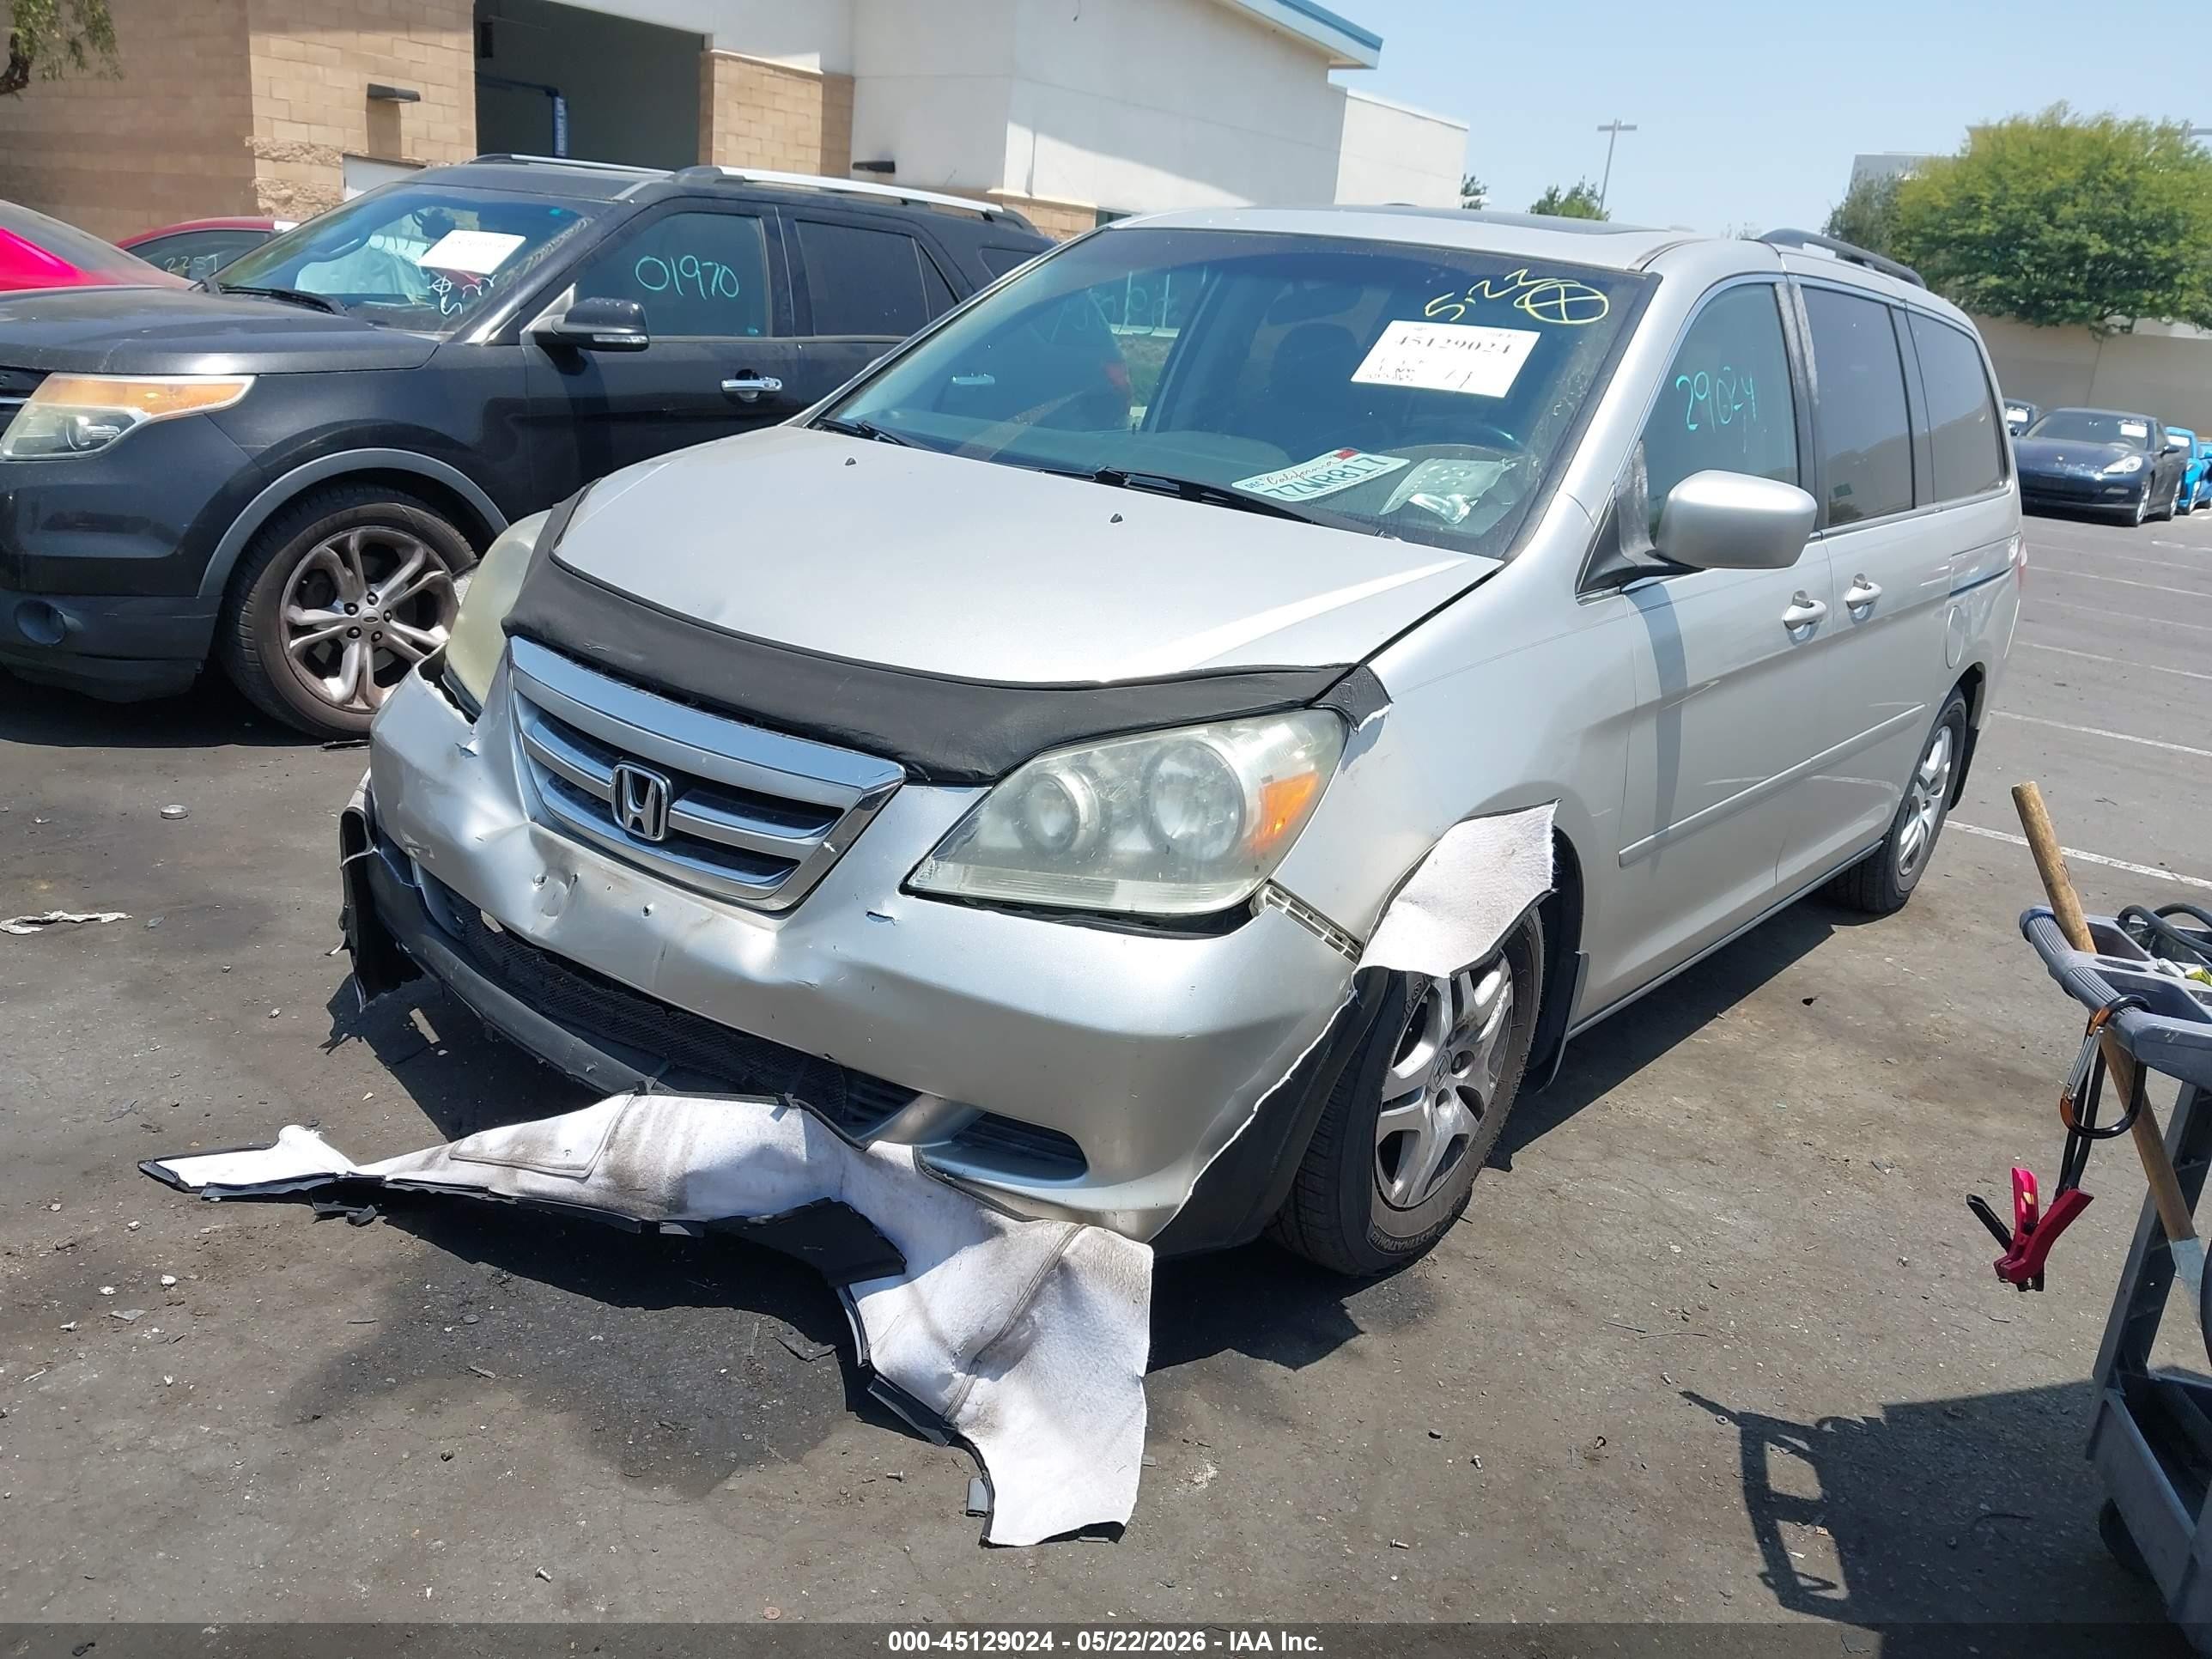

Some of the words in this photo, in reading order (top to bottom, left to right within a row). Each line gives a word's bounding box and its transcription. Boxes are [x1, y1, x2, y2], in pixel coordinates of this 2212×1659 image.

[635, 255, 738, 300] 01970
[1675, 366, 1757, 433] 29024
[1262, 457, 1389, 497] 7ZWR817
[1266, 459, 1343, 485] California
